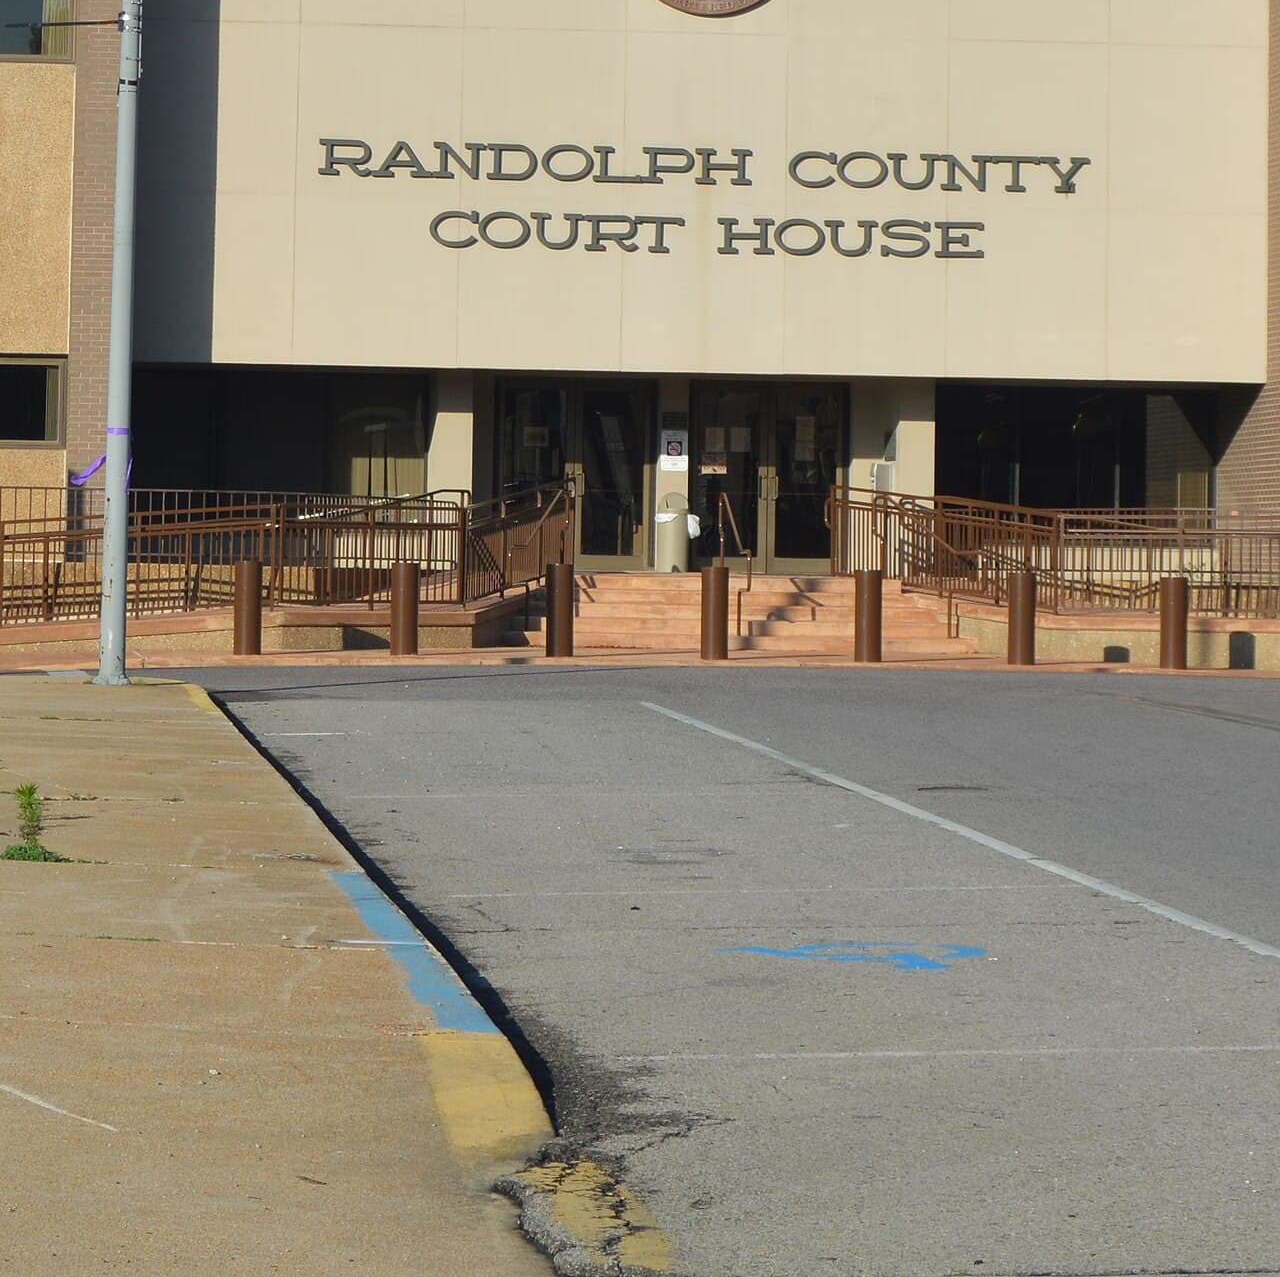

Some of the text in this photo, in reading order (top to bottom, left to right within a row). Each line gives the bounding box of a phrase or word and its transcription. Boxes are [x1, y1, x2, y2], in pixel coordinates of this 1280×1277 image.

[317, 138, 1092, 195] RANDOLPH COUNTY
[429, 210, 985, 259] COURT HOUSE
